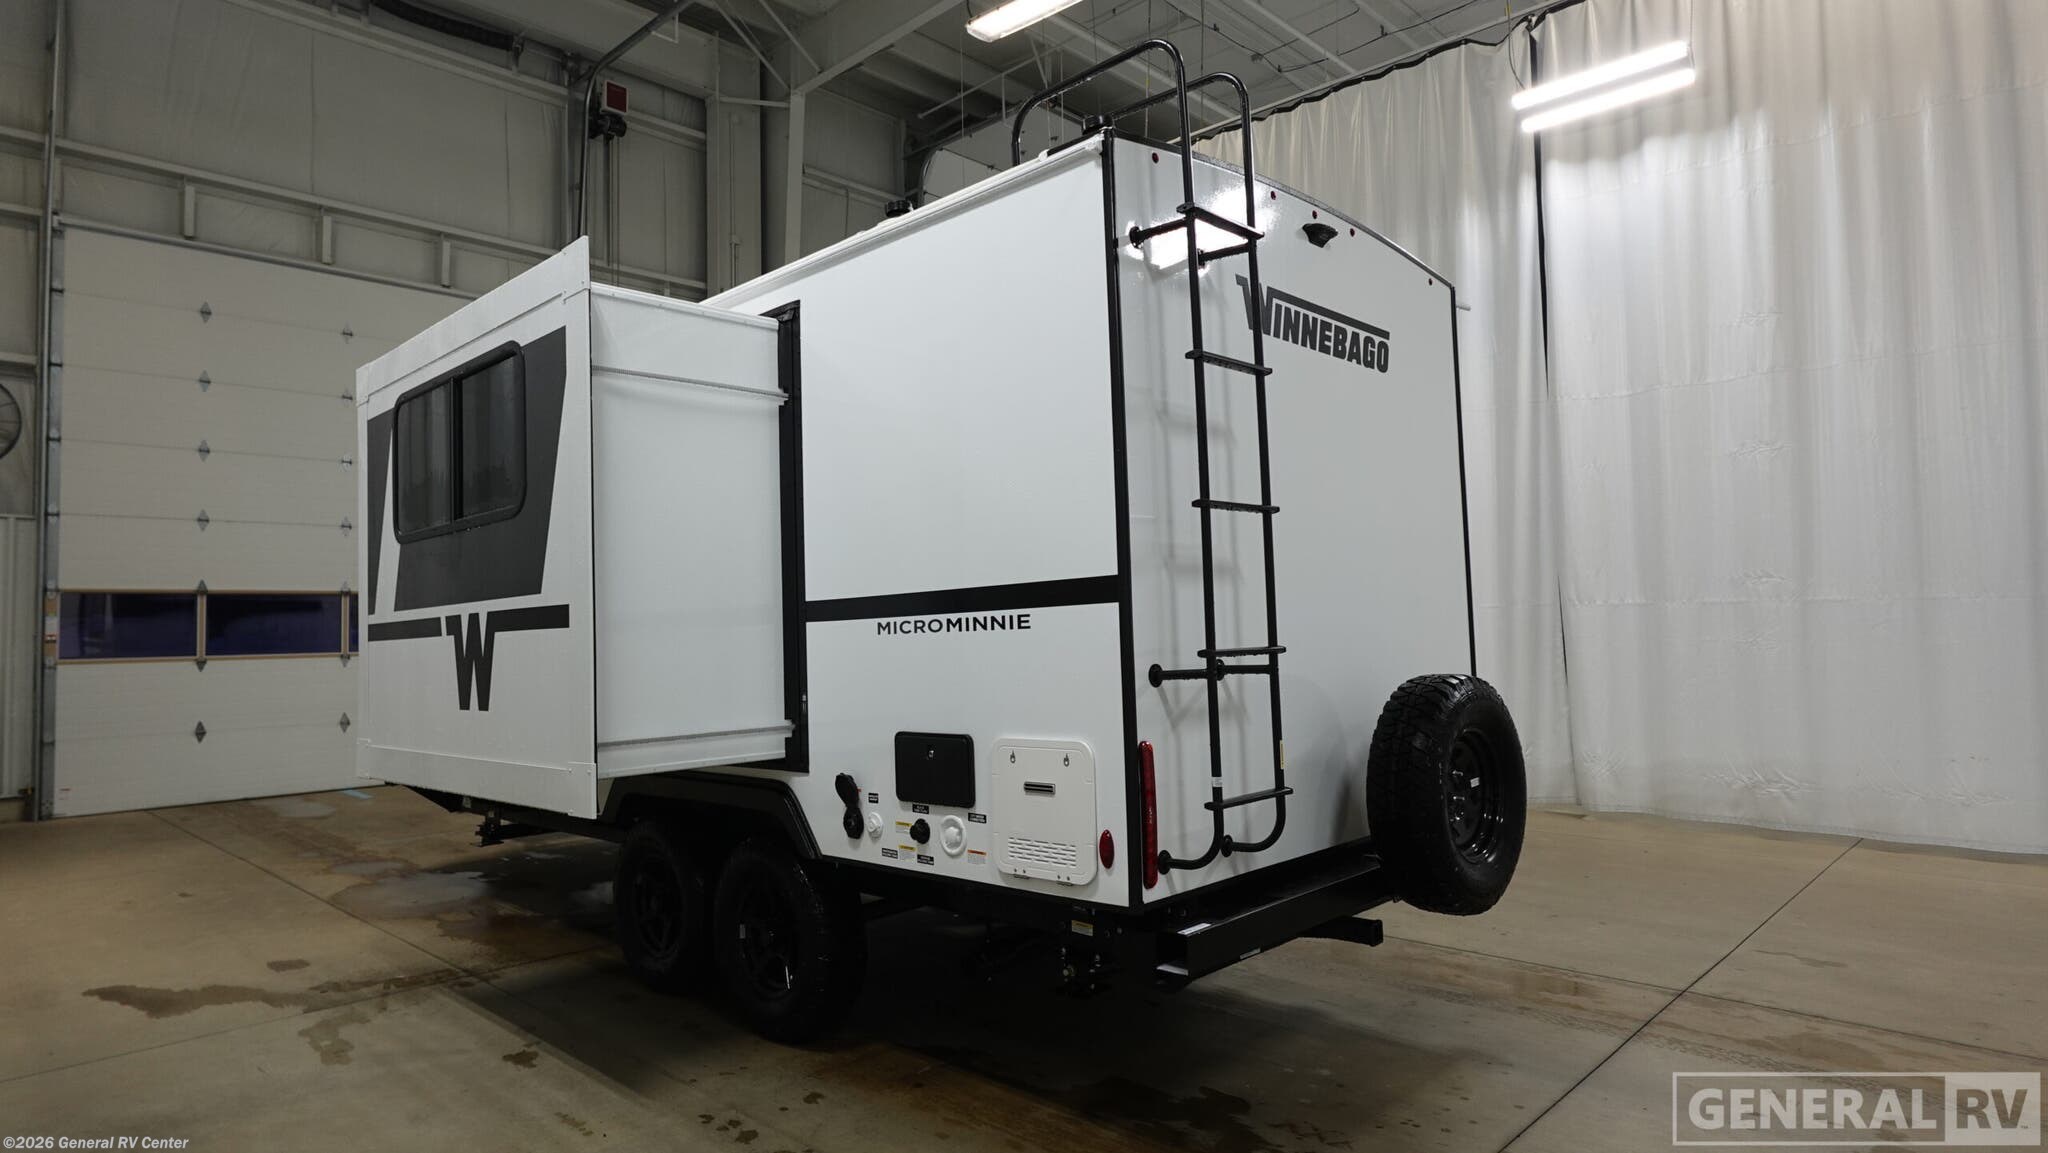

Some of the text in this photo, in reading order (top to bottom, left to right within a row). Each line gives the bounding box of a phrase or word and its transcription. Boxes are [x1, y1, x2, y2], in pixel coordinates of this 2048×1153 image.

[1235, 274, 1390, 373] WINNEBAGO
[445, 612, 495, 711] W
[877, 614, 1031, 635] MICROMINNIE
